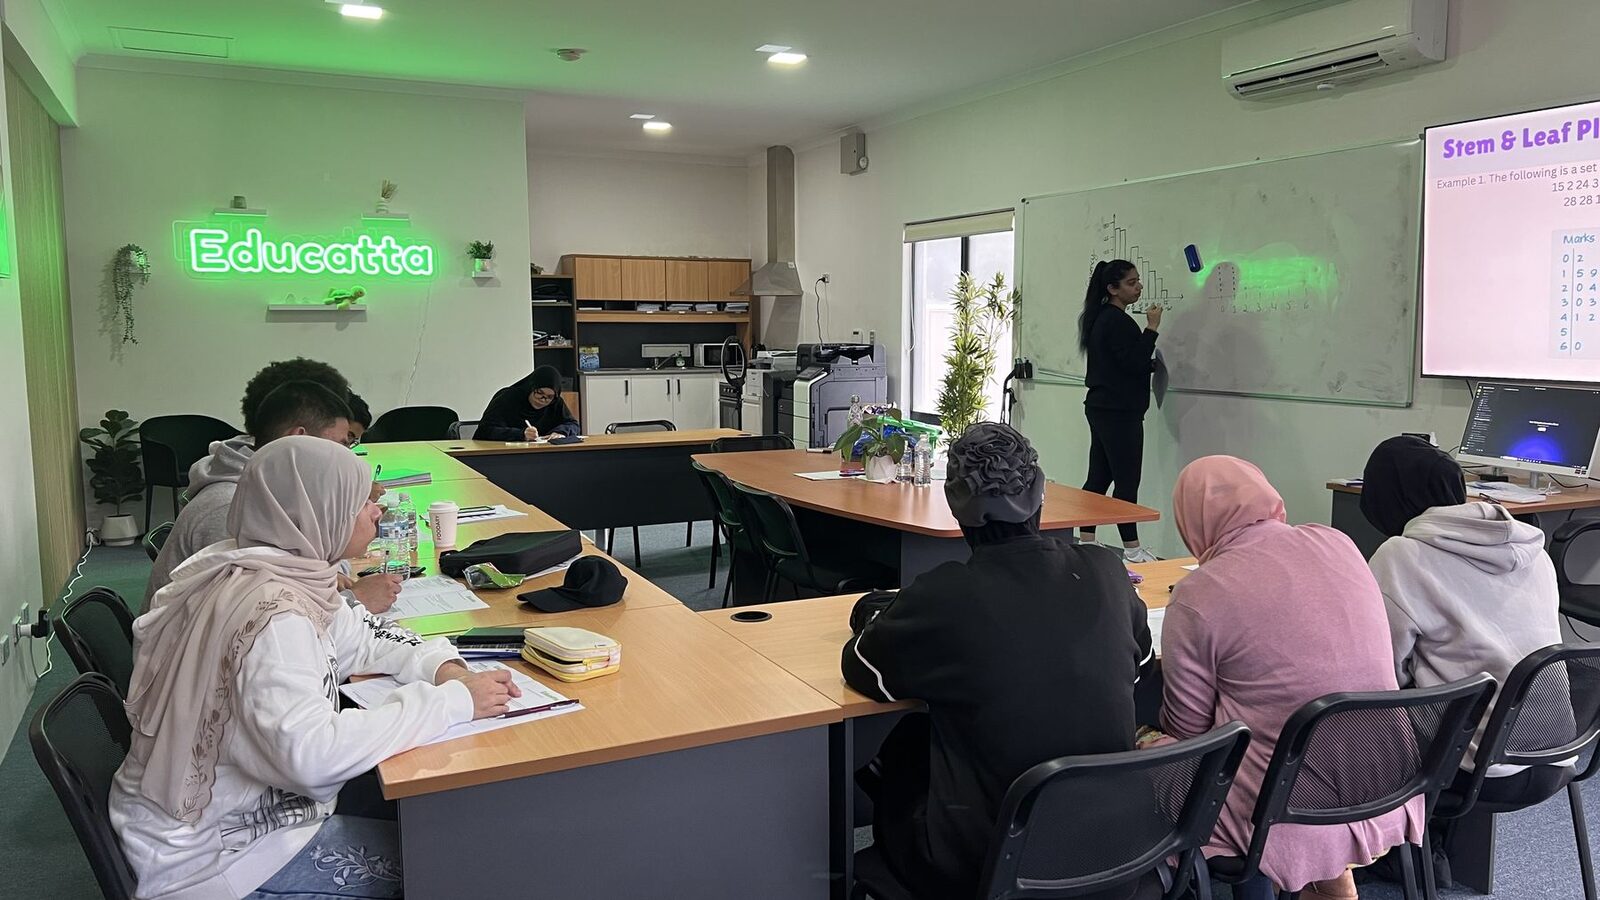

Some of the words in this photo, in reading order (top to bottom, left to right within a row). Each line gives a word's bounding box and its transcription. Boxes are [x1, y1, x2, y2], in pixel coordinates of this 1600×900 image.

[1443, 138, 1495, 159] Stem
[1501, 130, 1517, 151] &
[1522, 121, 1572, 148] Leaf
[1437, 176, 1476, 190] Example
[1489, 172, 1507, 185] The
[1509, 167, 1557, 181] following
[1560, 165, 1569, 176] is
[1571, 166, 1577, 175] a
[1580, 163, 1597, 174] set
[1552, 181, 1565, 192] 15
[1567, 180, 1574, 191] 2
[1576, 179, 1590, 190] 24
[1563, 196, 1577, 207] 28
[1579, 194, 1593, 205] 28
[1563, 233, 1596, 244] Marks
[189, 228, 434, 277] Educatta
[1562, 254, 1570, 263] 0
[1577, 254, 1584, 263] 2
[1576, 268, 1584, 278] 5
[1590, 268, 1598, 278] 9
[1561, 284, 1568, 293] 2
[1576, 282, 1583, 292] 0
[1589, 283, 1597, 292] 4
[1561, 298, 1569, 307] 3
[1575, 297, 1583, 307] 0
[1589, 297, 1597, 307] 3
[1560, 313, 1568, 322] 4
[1588, 313, 1595, 322] 2
[1560, 327, 1568, 337] 5
[1559, 341, 1568, 351] 6
[1574, 341, 1582, 351] 0
